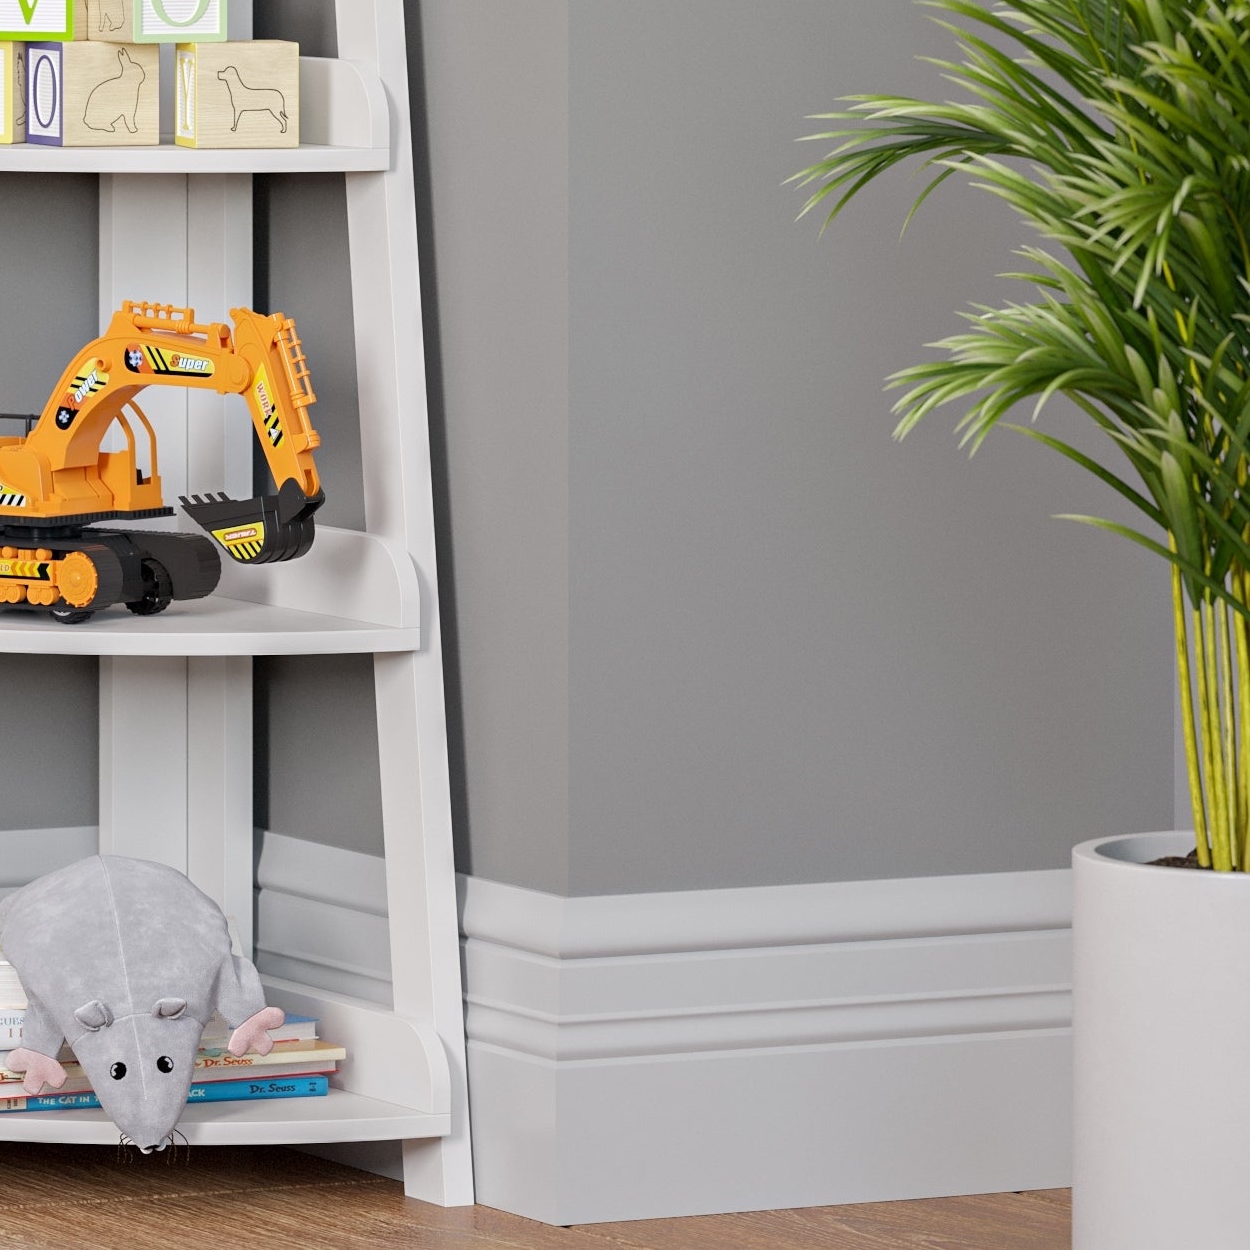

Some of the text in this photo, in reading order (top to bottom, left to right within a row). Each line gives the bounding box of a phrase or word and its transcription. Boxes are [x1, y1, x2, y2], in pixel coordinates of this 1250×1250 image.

[170, 353, 210, 371] Super
[66, 369, 99, 411] Power
[256, 382, 273, 419] WORK
[202, 1058, 222, 1068] Dr.
[223, 1056, 254, 1066] Seuss
[249, 1083, 296, 1094] Dr. Seuss
[37, 1097, 56, 1105] THE
[58, 1096, 77, 1105] CAT
